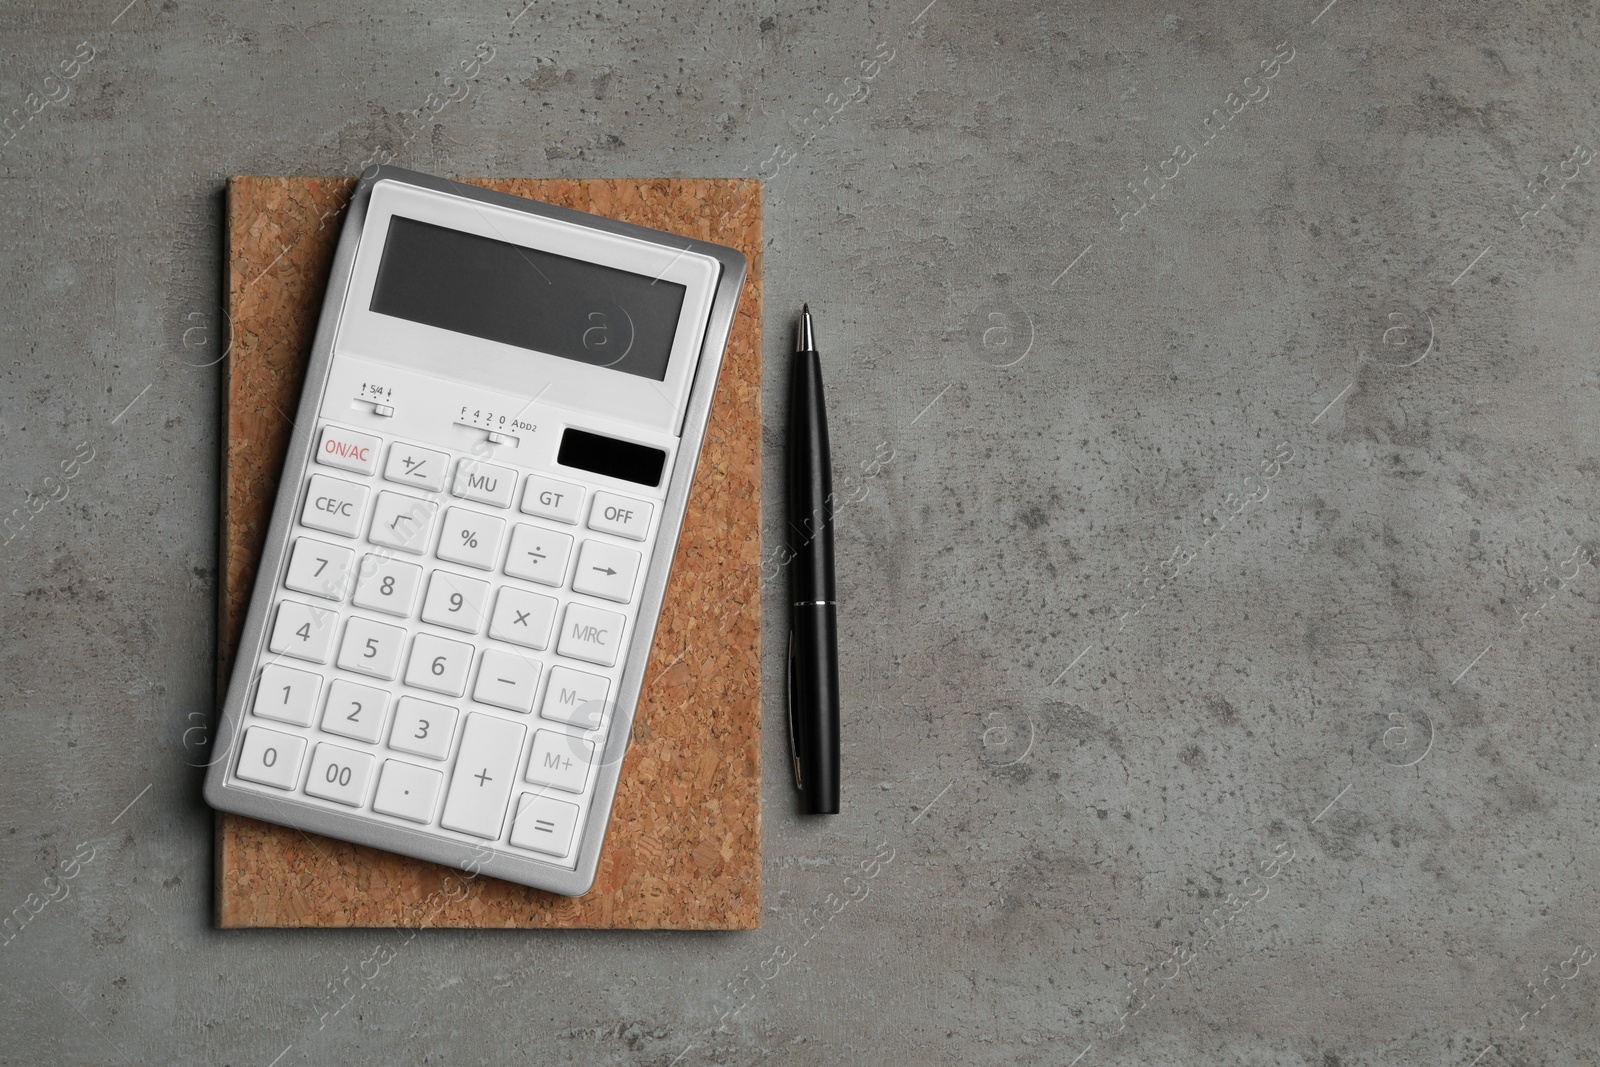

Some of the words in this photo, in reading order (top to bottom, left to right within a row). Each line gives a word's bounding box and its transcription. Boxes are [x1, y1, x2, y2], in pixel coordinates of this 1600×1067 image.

[370, 385, 383, 395] 5/4
[461, 406, 468, 415] F
[474, 410, 479, 418] 4
[487, 413, 492, 421] 2
[499, 416, 505, 424] 0
[325, 439, 369, 462] ON/AC
[467, 473, 498, 493] MU
[316, 497, 353, 516] CE/C
[540, 492, 563, 507] GT
[605, 507, 633, 523] OFF
[314, 558, 328, 577] 7
[380, 576, 395, 596] 8
[448, 593, 463, 612] 9
[296, 623, 310, 641] 4
[572, 624, 608, 646] MRC
[364, 638, 379, 658] 5
[432, 656, 446, 675] 6
[283, 686, 291, 704] 1
[347, 702, 361, 722] 2
[415, 720, 429, 739] 3
[263, 748, 277, 767] 0
[326, 764, 351, 786] 00
